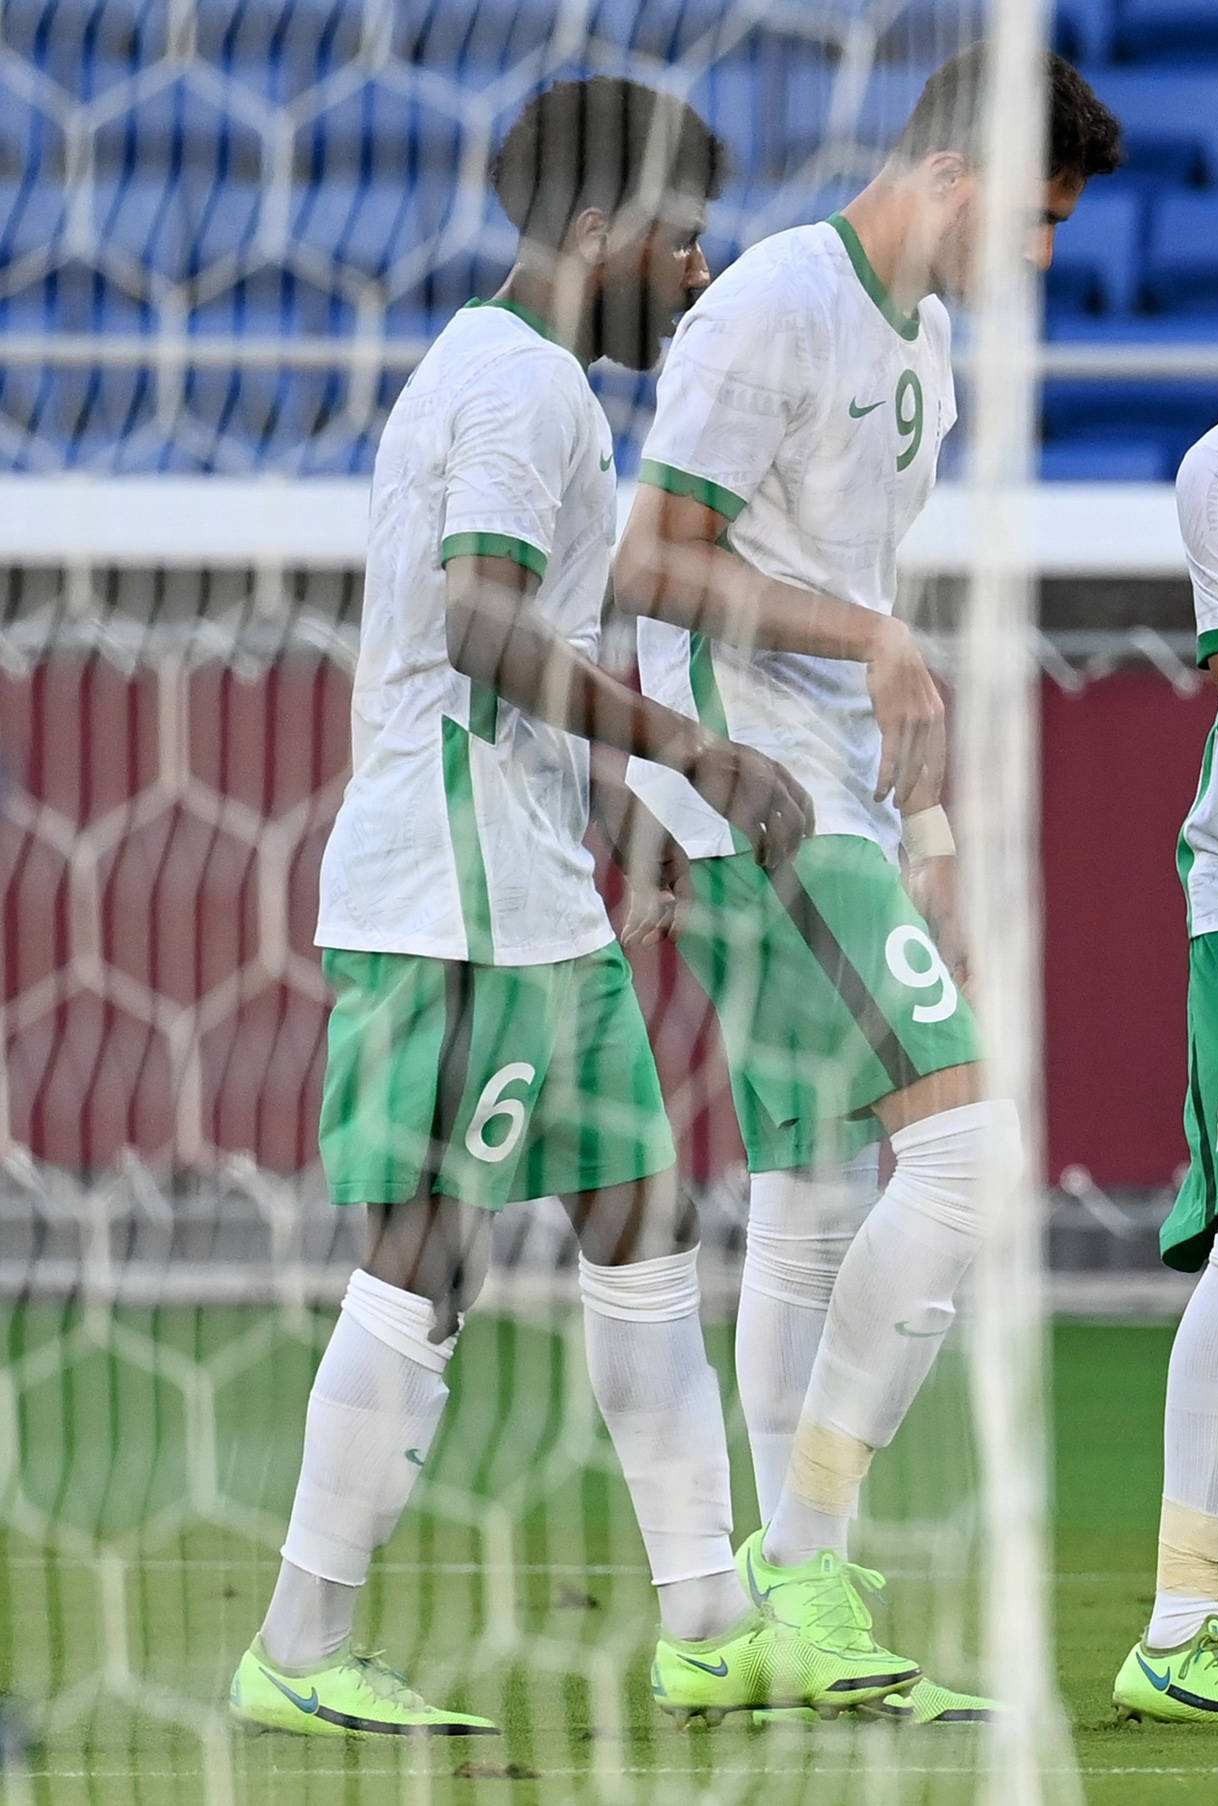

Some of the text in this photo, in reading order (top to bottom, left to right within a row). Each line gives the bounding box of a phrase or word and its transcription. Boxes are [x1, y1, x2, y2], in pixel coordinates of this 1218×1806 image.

[895, 369, 923, 473] 9
[885, 924, 958, 1023] 9
[464, 1062, 536, 1163] 6
